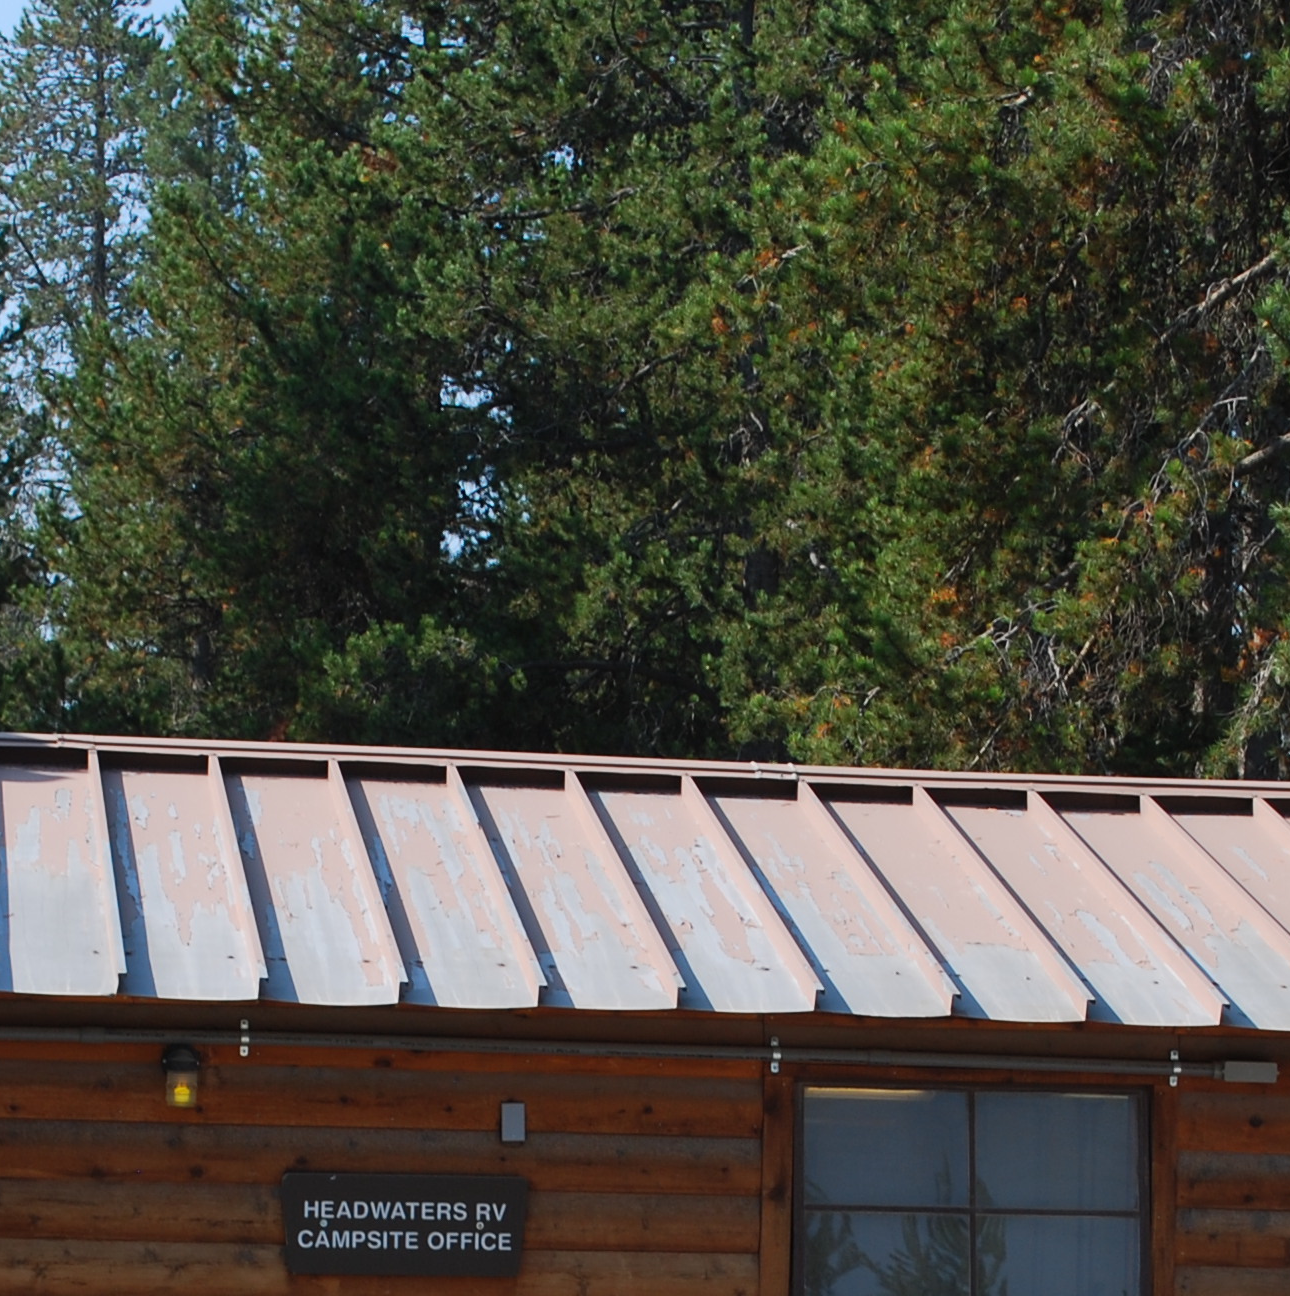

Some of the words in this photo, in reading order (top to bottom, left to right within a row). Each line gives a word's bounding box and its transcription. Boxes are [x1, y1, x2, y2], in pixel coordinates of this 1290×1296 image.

[304, 1200, 468, 1221] HEADWATERS
[476, 1203, 507, 1221] RV
[297, 1229, 419, 1249] CAMPSITE
[427, 1231, 512, 1251] OFFICE
